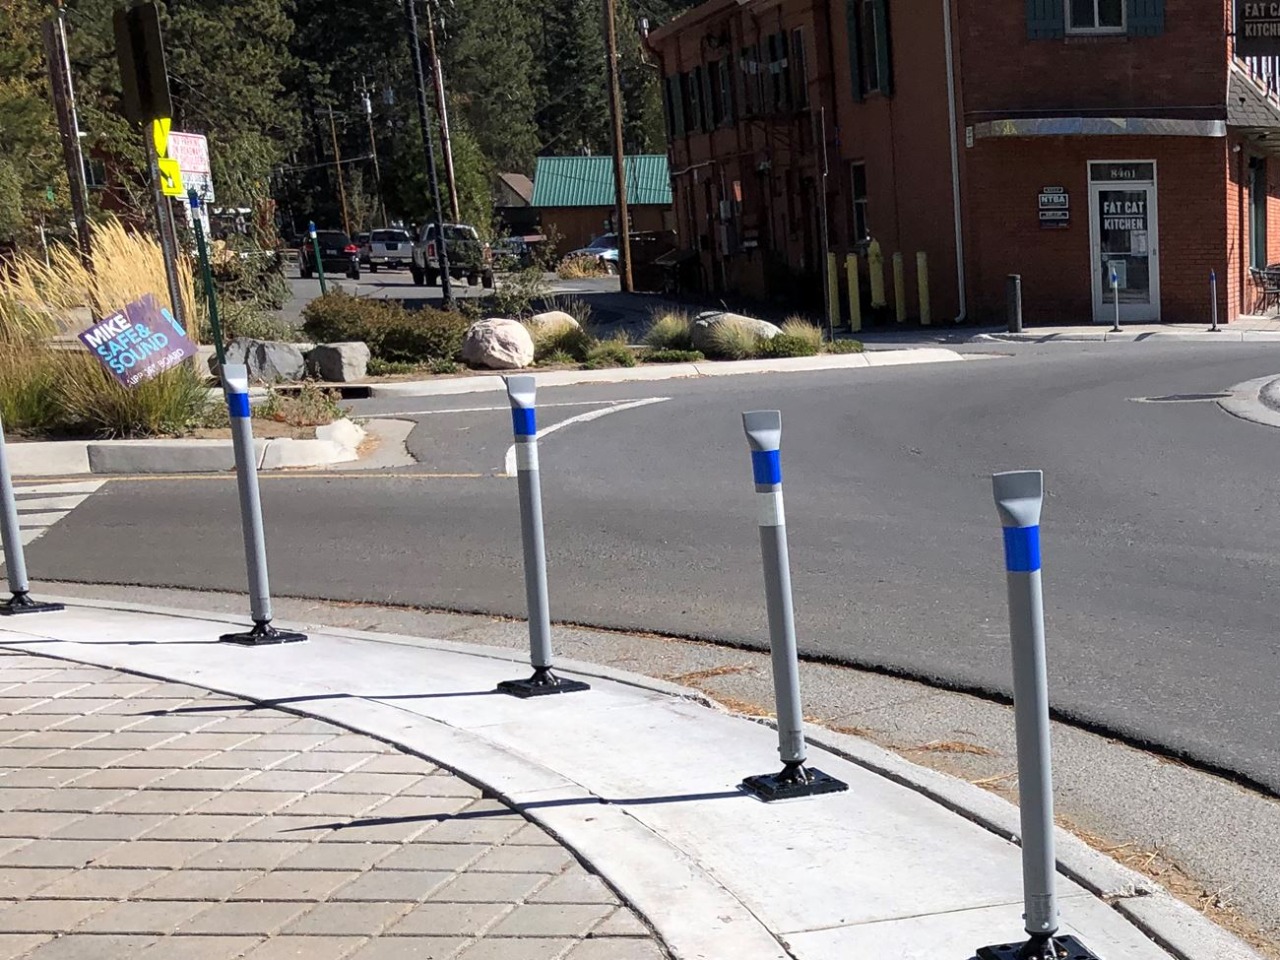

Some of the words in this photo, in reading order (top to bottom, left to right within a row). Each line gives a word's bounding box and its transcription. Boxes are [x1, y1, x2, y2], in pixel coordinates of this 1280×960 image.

[1245, 3, 1266, 17] FAT
[1103, 201, 1122, 214] FAT
[1124, 201, 1144, 213] CAT
[1104, 218, 1143, 230] KITCHEN
[84, 313, 132, 348] MIKE
[109, 332, 169, 374] SOUND
[157, 348, 185, 369] BOARD
